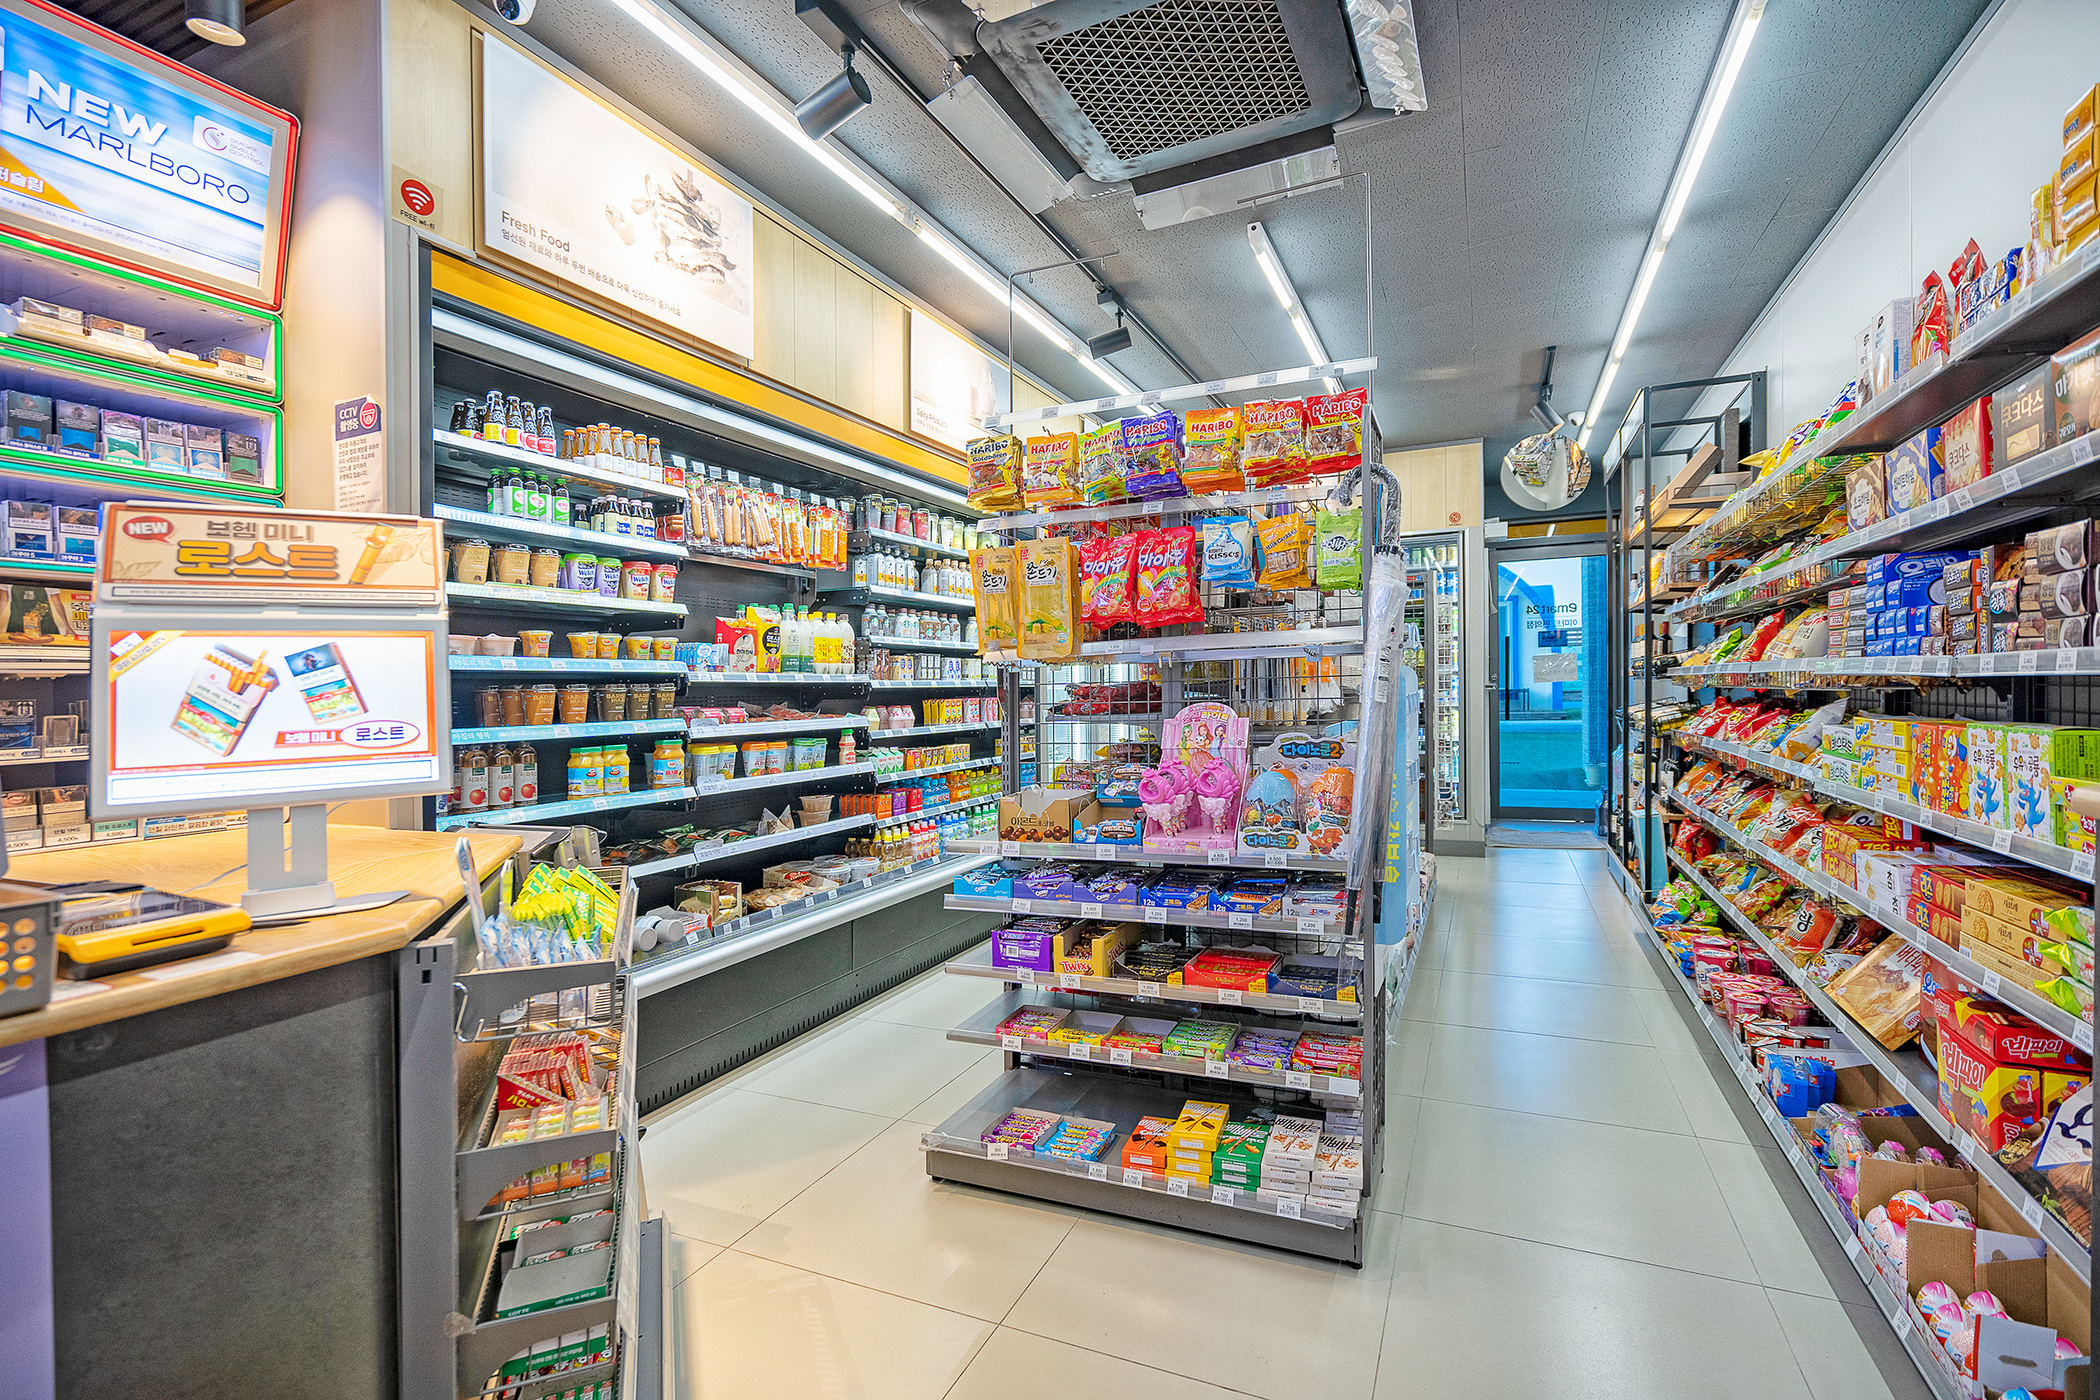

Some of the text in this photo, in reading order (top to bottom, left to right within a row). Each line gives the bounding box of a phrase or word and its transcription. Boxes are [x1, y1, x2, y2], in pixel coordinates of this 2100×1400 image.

[28, 68, 168, 146] NEW
[26, 103, 250, 204] MARLBORO
[400, 210, 418, 223] FREE
[501, 210, 570, 253] Fresh Food
[340, 406, 358, 420] CCTV
[1250, 406, 1296, 425] HARIBO
[1312, 397, 1362, 418] HARIBO
[2002, 388, 2044, 428] 쿠크다스
[1126, 419, 1167, 438] HARIBO
[1191, 419, 1234, 434] HARIBO
[1084, 429, 1120, 449] HARIBO
[1199, 432, 1226, 440] Peaches
[970, 440, 1008, 456] HARIBO
[1030, 441, 1070, 455] HARIBO
[128, 521, 169, 535] NEW
[264, 524, 314, 542] 미니
[1264, 540, 1278, 552] Milk
[1320, 536, 1358, 552] eclipse
[174, 539, 340, 580] 로스트
[1082, 556, 1128, 575] 마이쮸
[1138, 548, 1186, 568] 마이쮸
[1898, 555, 1958, 578] 오레오
[356, 726, 404, 742] 로스트
[1061, 961, 1088, 972] Twix
